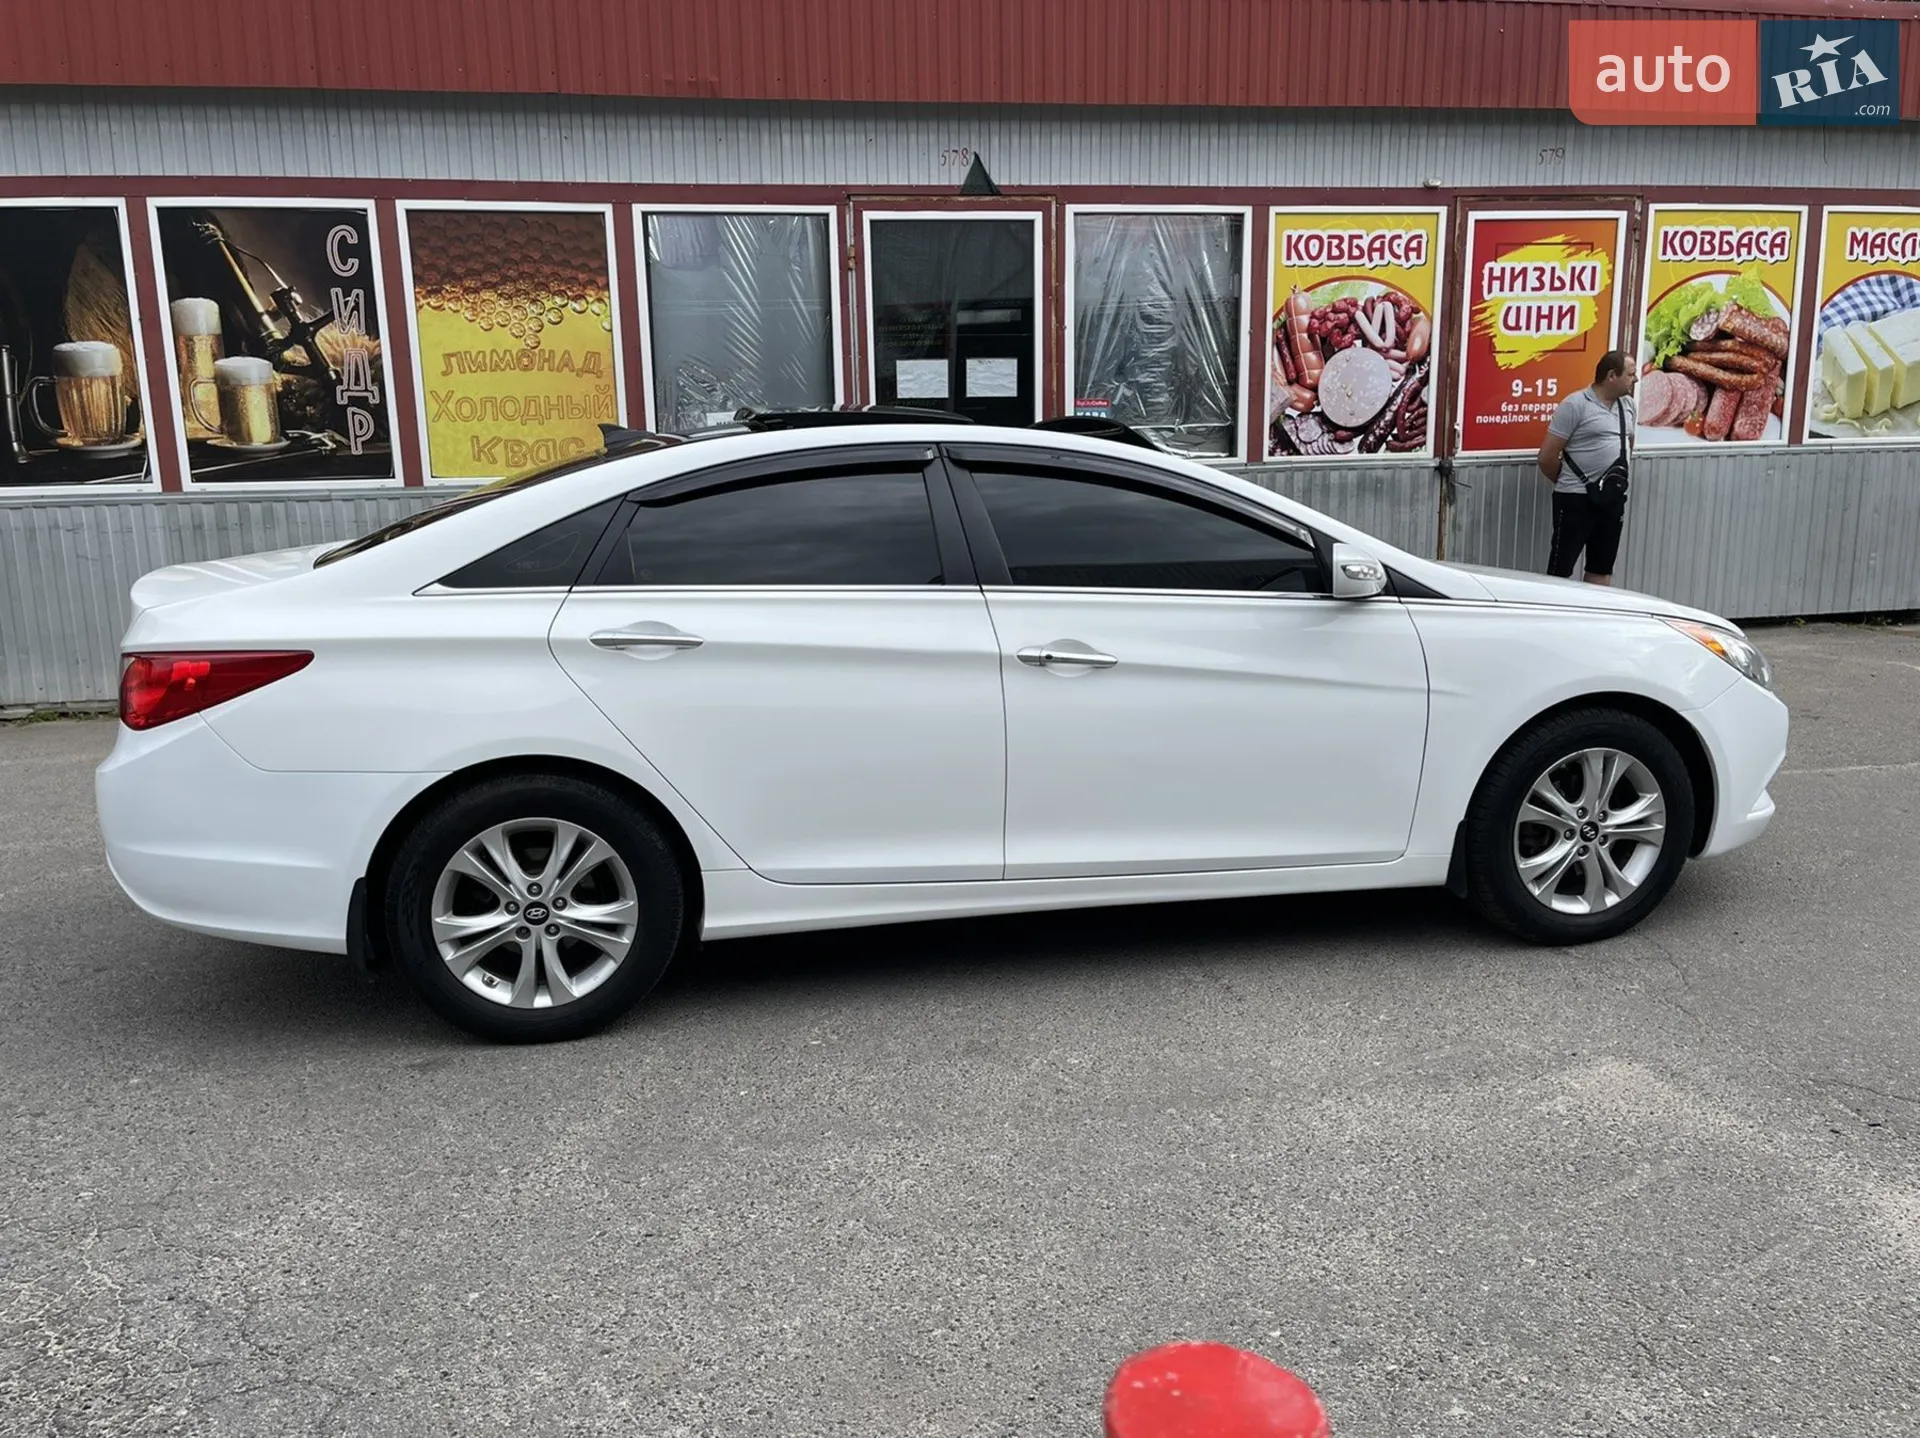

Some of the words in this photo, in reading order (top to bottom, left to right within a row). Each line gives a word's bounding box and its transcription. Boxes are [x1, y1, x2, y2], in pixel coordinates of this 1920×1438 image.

[940, 147, 969, 167] 578
[1538, 147, 1565, 165] 579
[1285, 233, 1424, 263] КОВБАСА
[1661, 229, 1788, 259] КОВБАСА
[1848, 230, 1920, 260] МАСЛ
[1486, 265, 1598, 296] НИЗЬКІ
[1501, 304, 1577, 334] ЦІНИ
[326, 224, 380, 456] СИДР
[441, 348, 604, 378] ЛИМОНАД
[1511, 378, 1558, 398] 9-15
[430, 384, 614, 426] Холодный
[1475, 412, 1531, 424] понеділок
[1501, 401, 1519, 412] без
[1521, 402, 1559, 413] перерв
